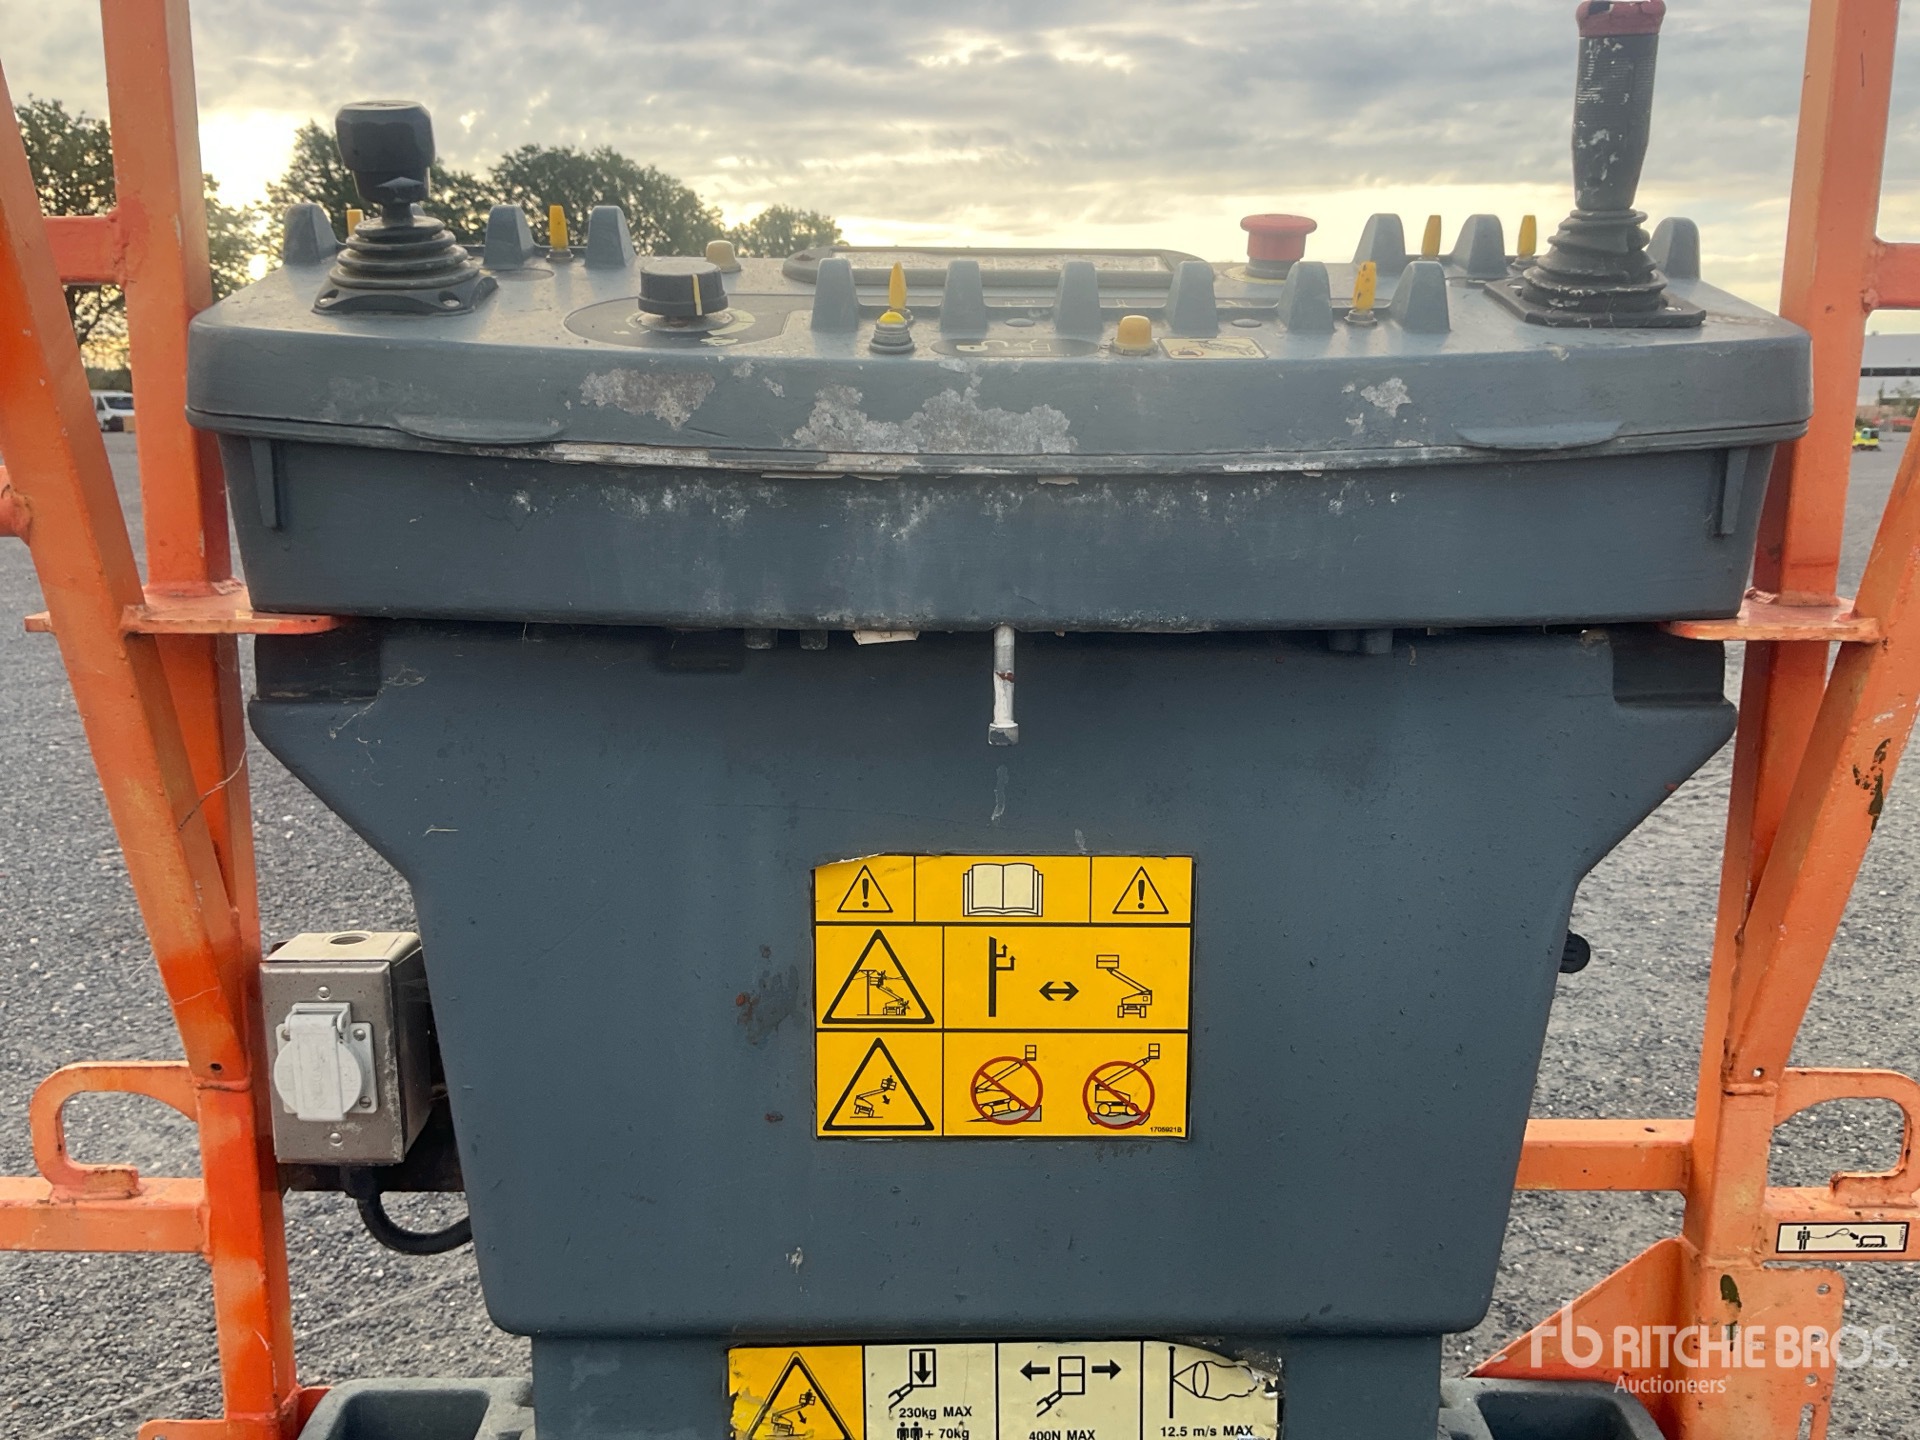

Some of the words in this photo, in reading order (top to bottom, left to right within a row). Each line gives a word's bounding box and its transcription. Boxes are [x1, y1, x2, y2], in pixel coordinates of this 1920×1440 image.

[898, 1407, 937, 1420] 230kg
[943, 1406, 972, 1417] MAX
[938, 1428, 970, 1440] 70kg
[1028, 1430, 1061, 1440] 400N
[1066, 1429, 1095, 1440] MAX
[1160, 1426, 1188, 1437] 12.5
[1193, 1425, 1217, 1437] m/s
[1223, 1425, 1253, 1436] MAX
